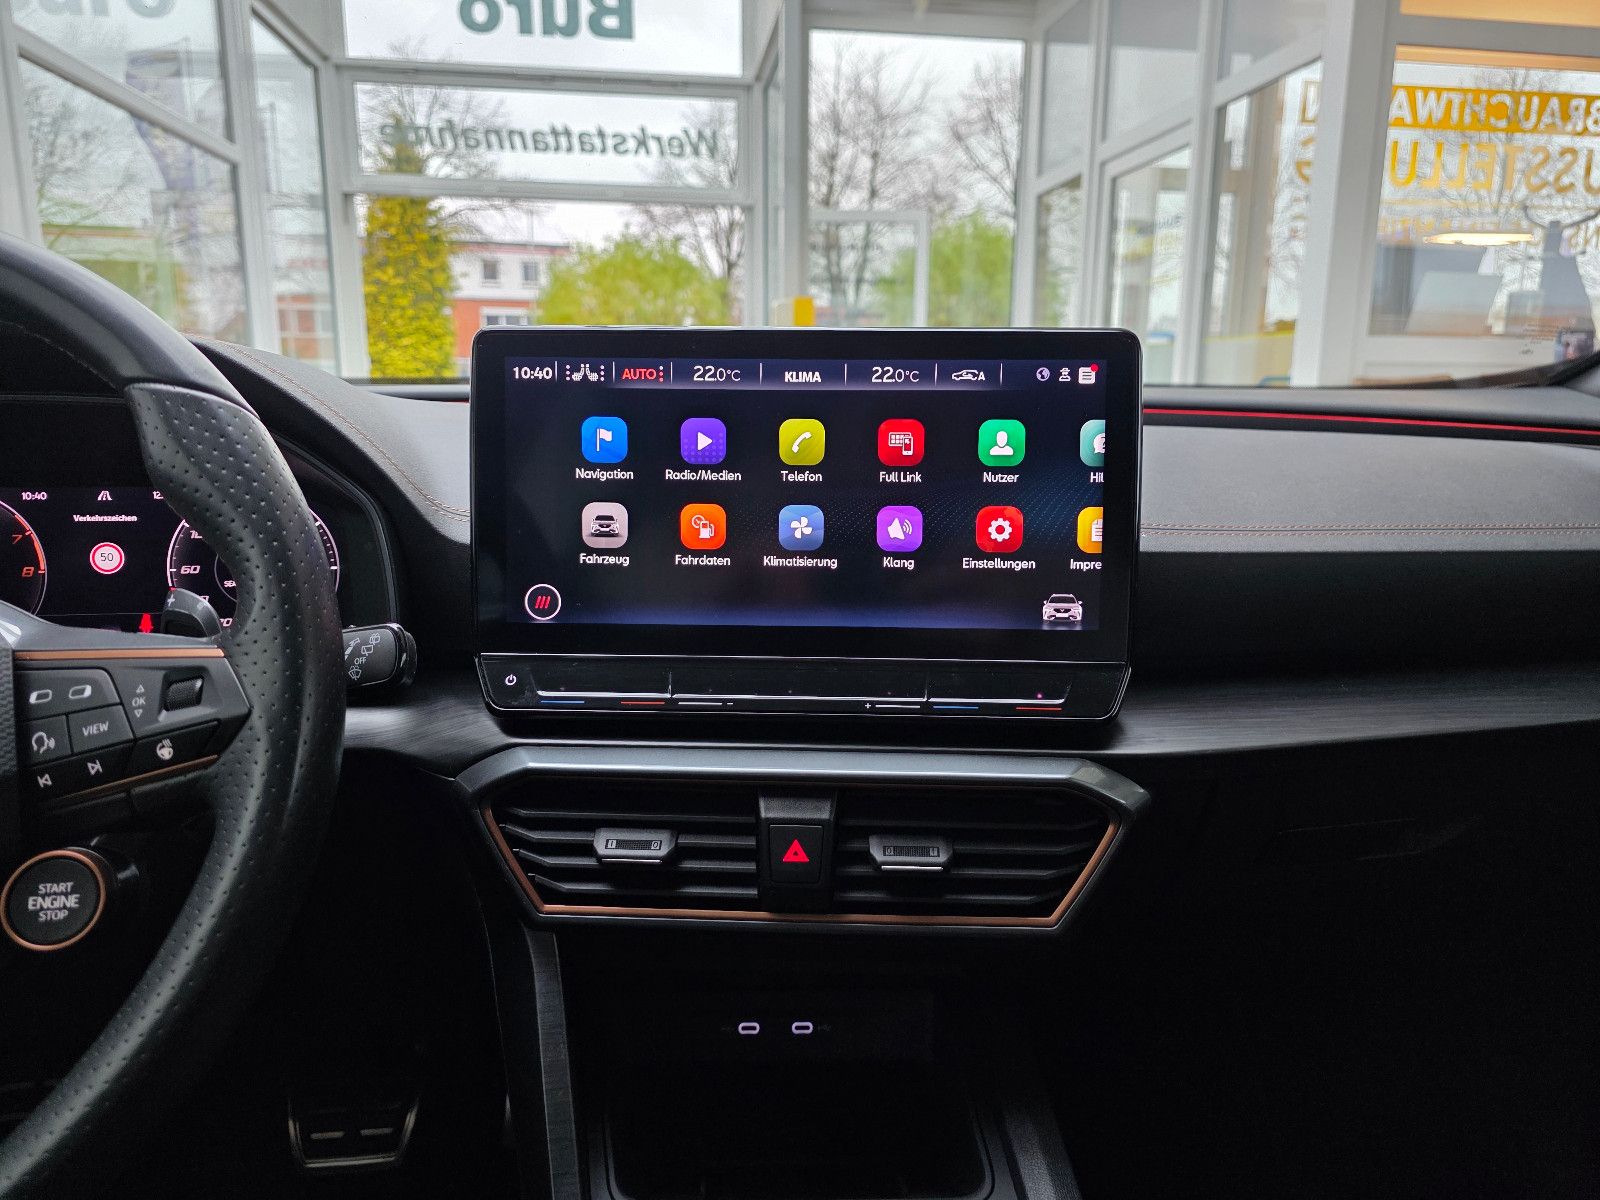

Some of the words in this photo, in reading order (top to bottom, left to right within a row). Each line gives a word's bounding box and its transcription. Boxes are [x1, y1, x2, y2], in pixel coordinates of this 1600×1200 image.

[513, 366, 553, 380] 10:40
[622, 368, 657, 380] AUTO
[693, 365, 741, 382] 22.0°C
[784, 371, 822, 383] KLIMA
[871, 366, 920, 383] 22.0°C
[575, 468, 634, 482] Navigation
[665, 469, 742, 482] Radio/Medien
[781, 470, 823, 482] Telefon
[879, 471, 899, 483] Full
[900, 471, 922, 483] Link
[983, 472, 1020, 483] Nutzer
[21, 490, 47, 501] 10:40
[72, 513, 138, 523] Verkehrszeichen
[11, 534, 22, 545] 7
[100, 551, 114, 562] 50
[579, 553, 630, 567] Fahrzeug
[675, 554, 731, 566] Fahrdaten
[763, 555, 838, 569] Klimatisierung
[883, 556, 915, 570] Klang
[962, 557, 1036, 570] Einstellungen
[1069, 558, 1102, 570] Impre
[21, 566, 34, 578] 8
[180, 565, 201, 575] 60
[354, 656, 367, 665] OFF
[131, 696, 146, 707] OK
[82, 720, 109, 737] VIEW
[38, 881, 74, 895] START
[27, 894, 81, 912] ENGINE
[38, 909, 69, 922] STOP
